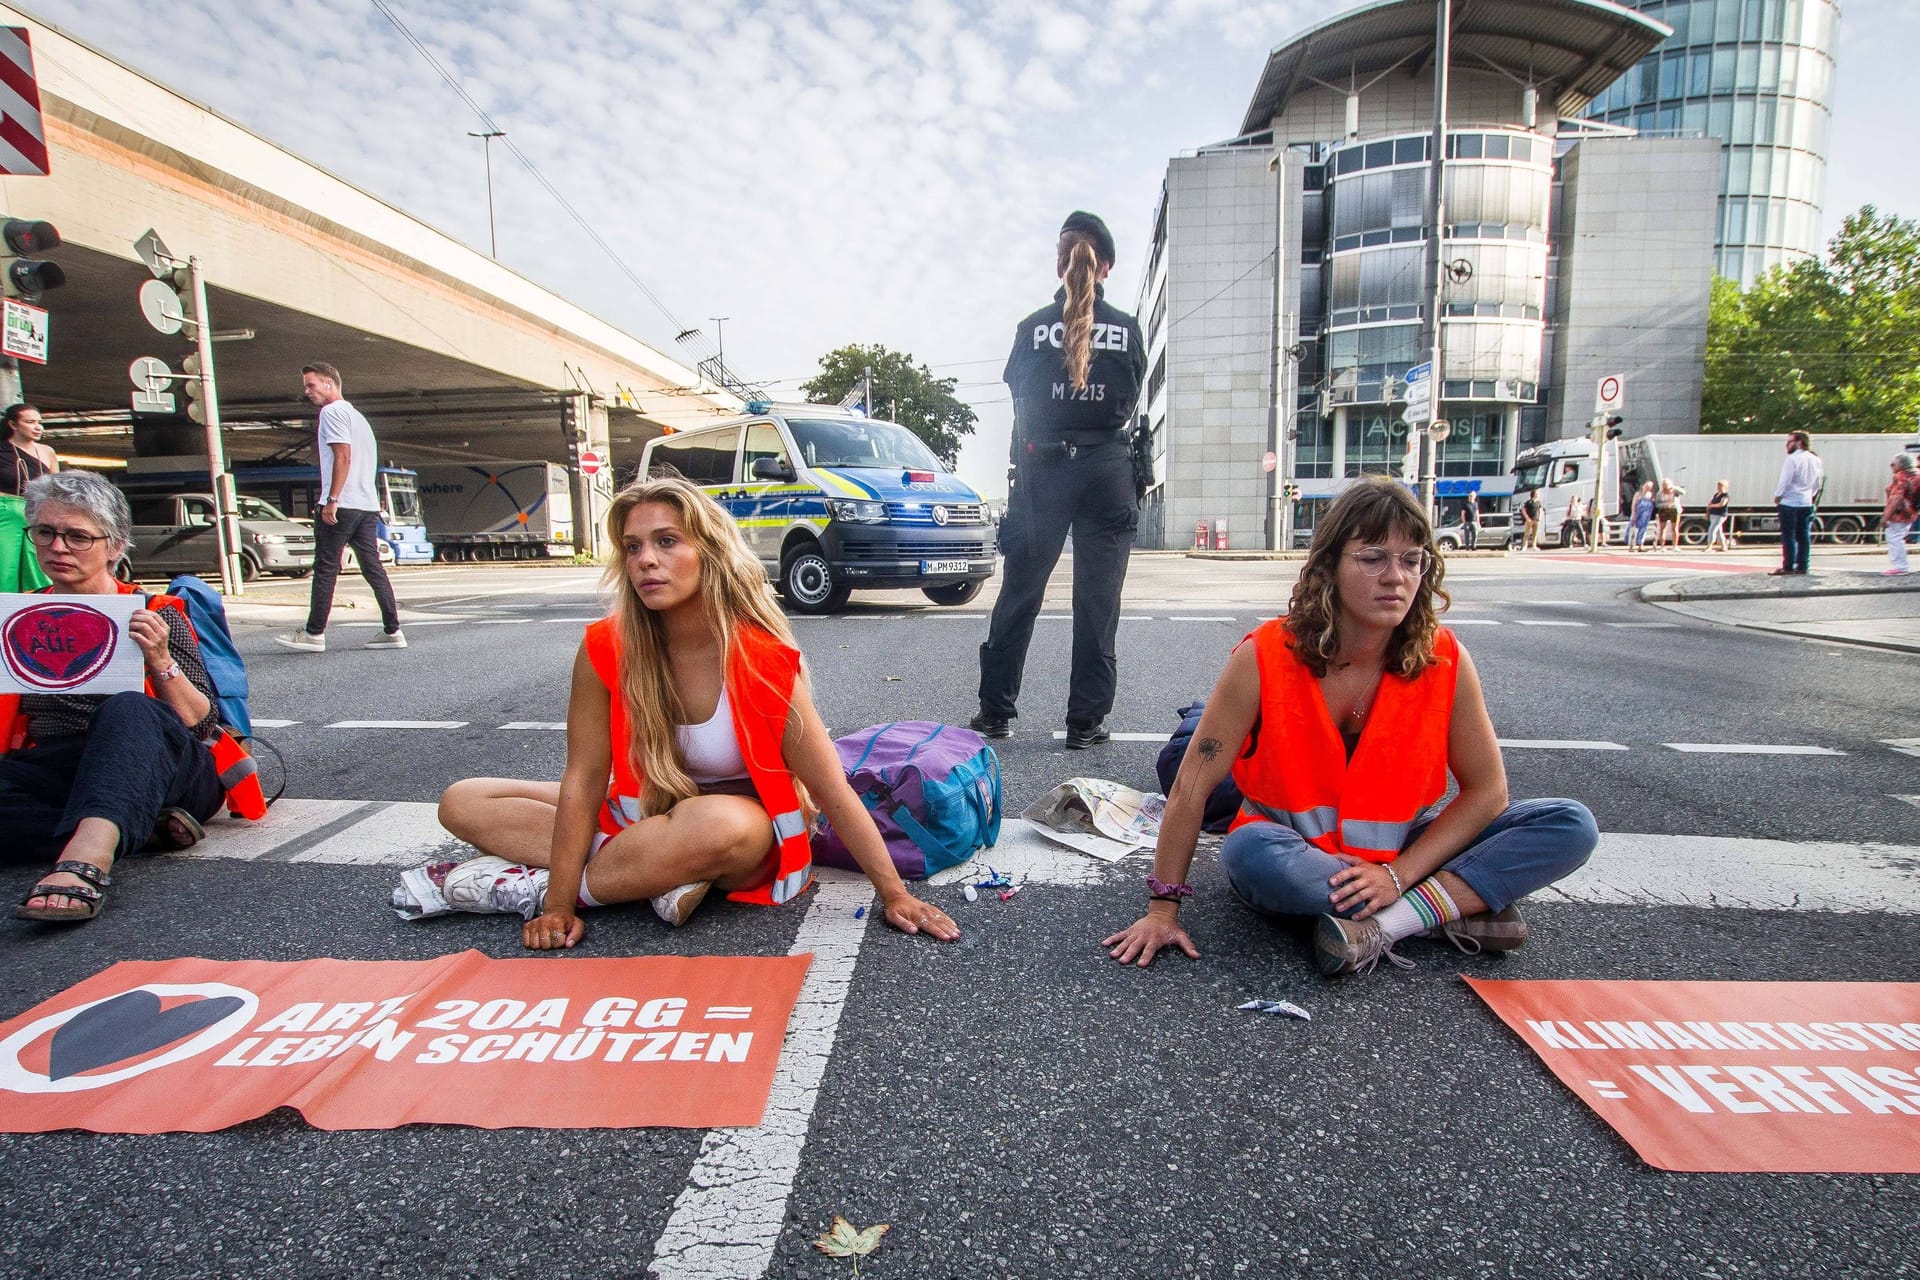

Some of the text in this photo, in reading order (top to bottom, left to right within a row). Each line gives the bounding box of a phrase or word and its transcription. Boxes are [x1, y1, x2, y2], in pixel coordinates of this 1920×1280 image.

[1034, 322, 1128, 352] POZEI
[1052, 382, 1105, 401] M 7213
[1367, 416, 1470, 437] Acis
[419, 483, 463, 494] where
[949, 562, 967, 572] 9312
[417, 996, 570, 1031] 20A
[583, 996, 691, 1028] GG
[415, 1025, 753, 1065] SCHÜTZEN
[1629, 1064, 1920, 1115] VERFAS
